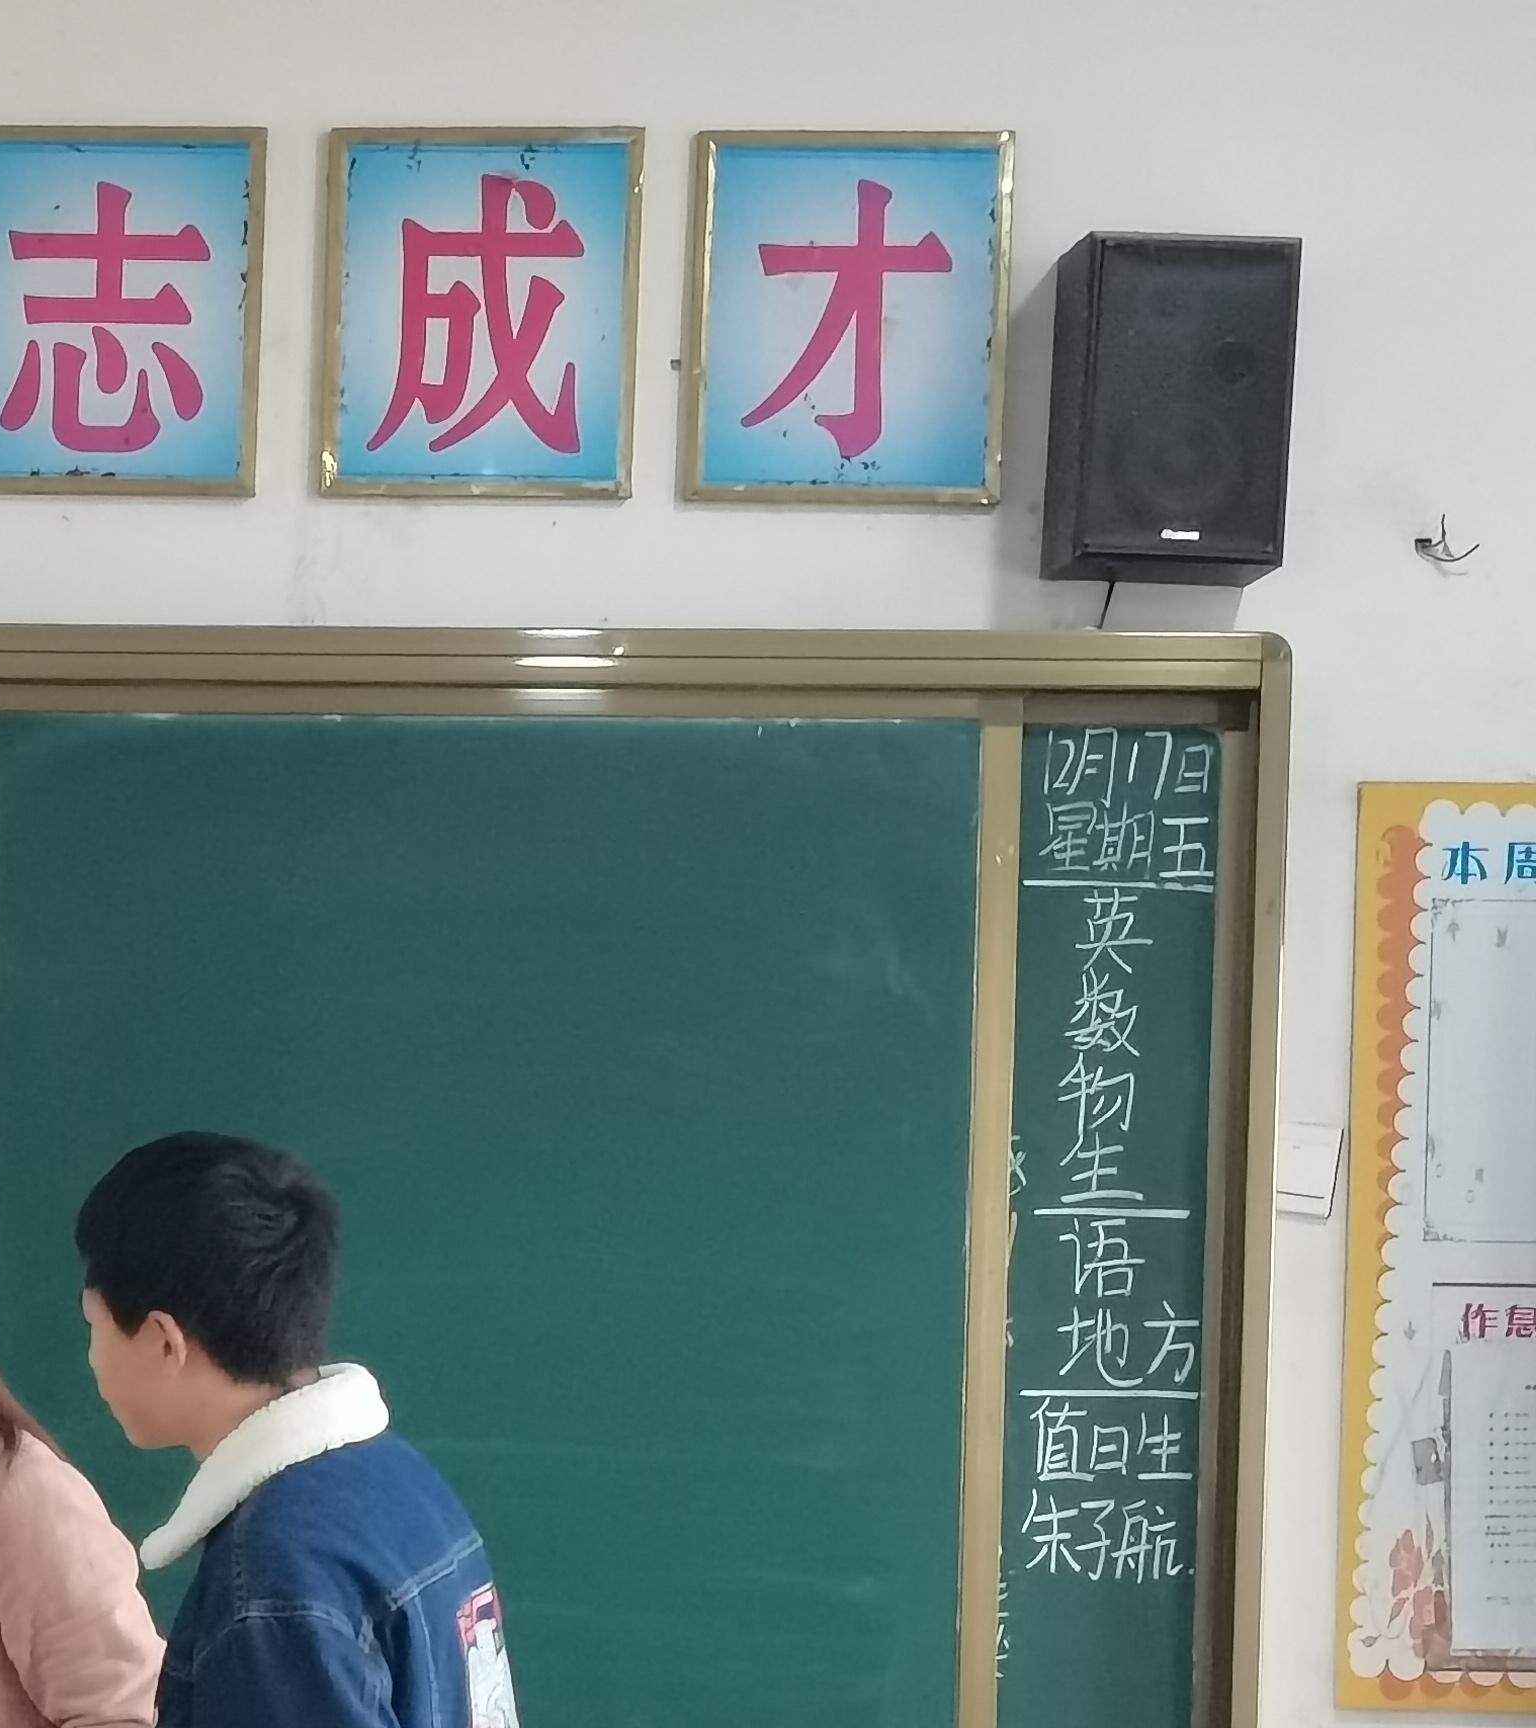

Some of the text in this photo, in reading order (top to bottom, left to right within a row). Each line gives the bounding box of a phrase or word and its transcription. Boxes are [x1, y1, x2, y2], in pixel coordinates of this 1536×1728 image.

[1042, 727, 1214, 808] 12月17日
[1038, 801, 1214, 880] 星期五
[1059, 1218, 1145, 1297] 语
[1058, 1301, 1199, 1387] 地方
[1030, 1397, 1192, 1481] 值日生
[1022, 1488, 1184, 1583] 朱子航
